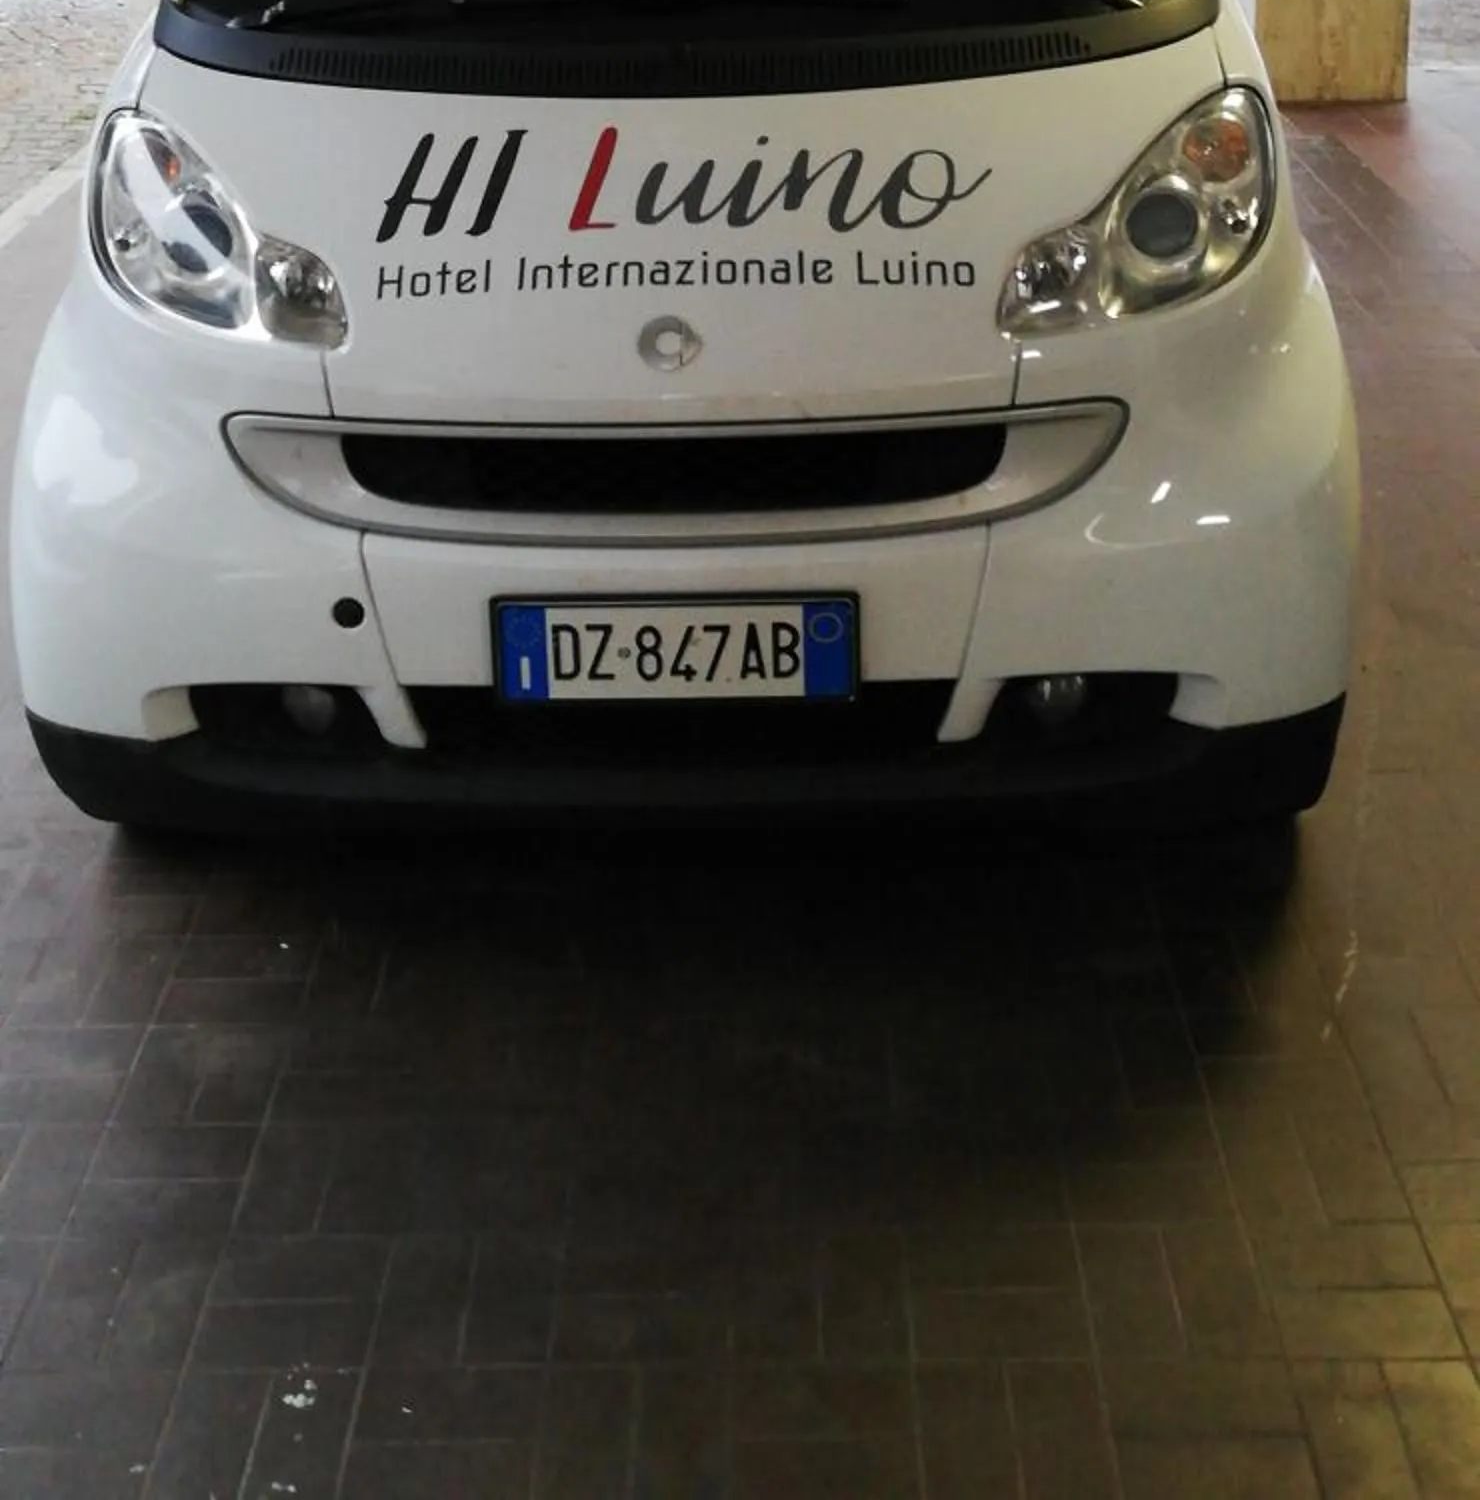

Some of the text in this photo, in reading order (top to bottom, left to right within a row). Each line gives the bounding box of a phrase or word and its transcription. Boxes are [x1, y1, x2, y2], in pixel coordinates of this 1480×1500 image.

[376, 126, 993, 243] HI Luino
[377, 250, 977, 300] Hotel Internazionale Luino
